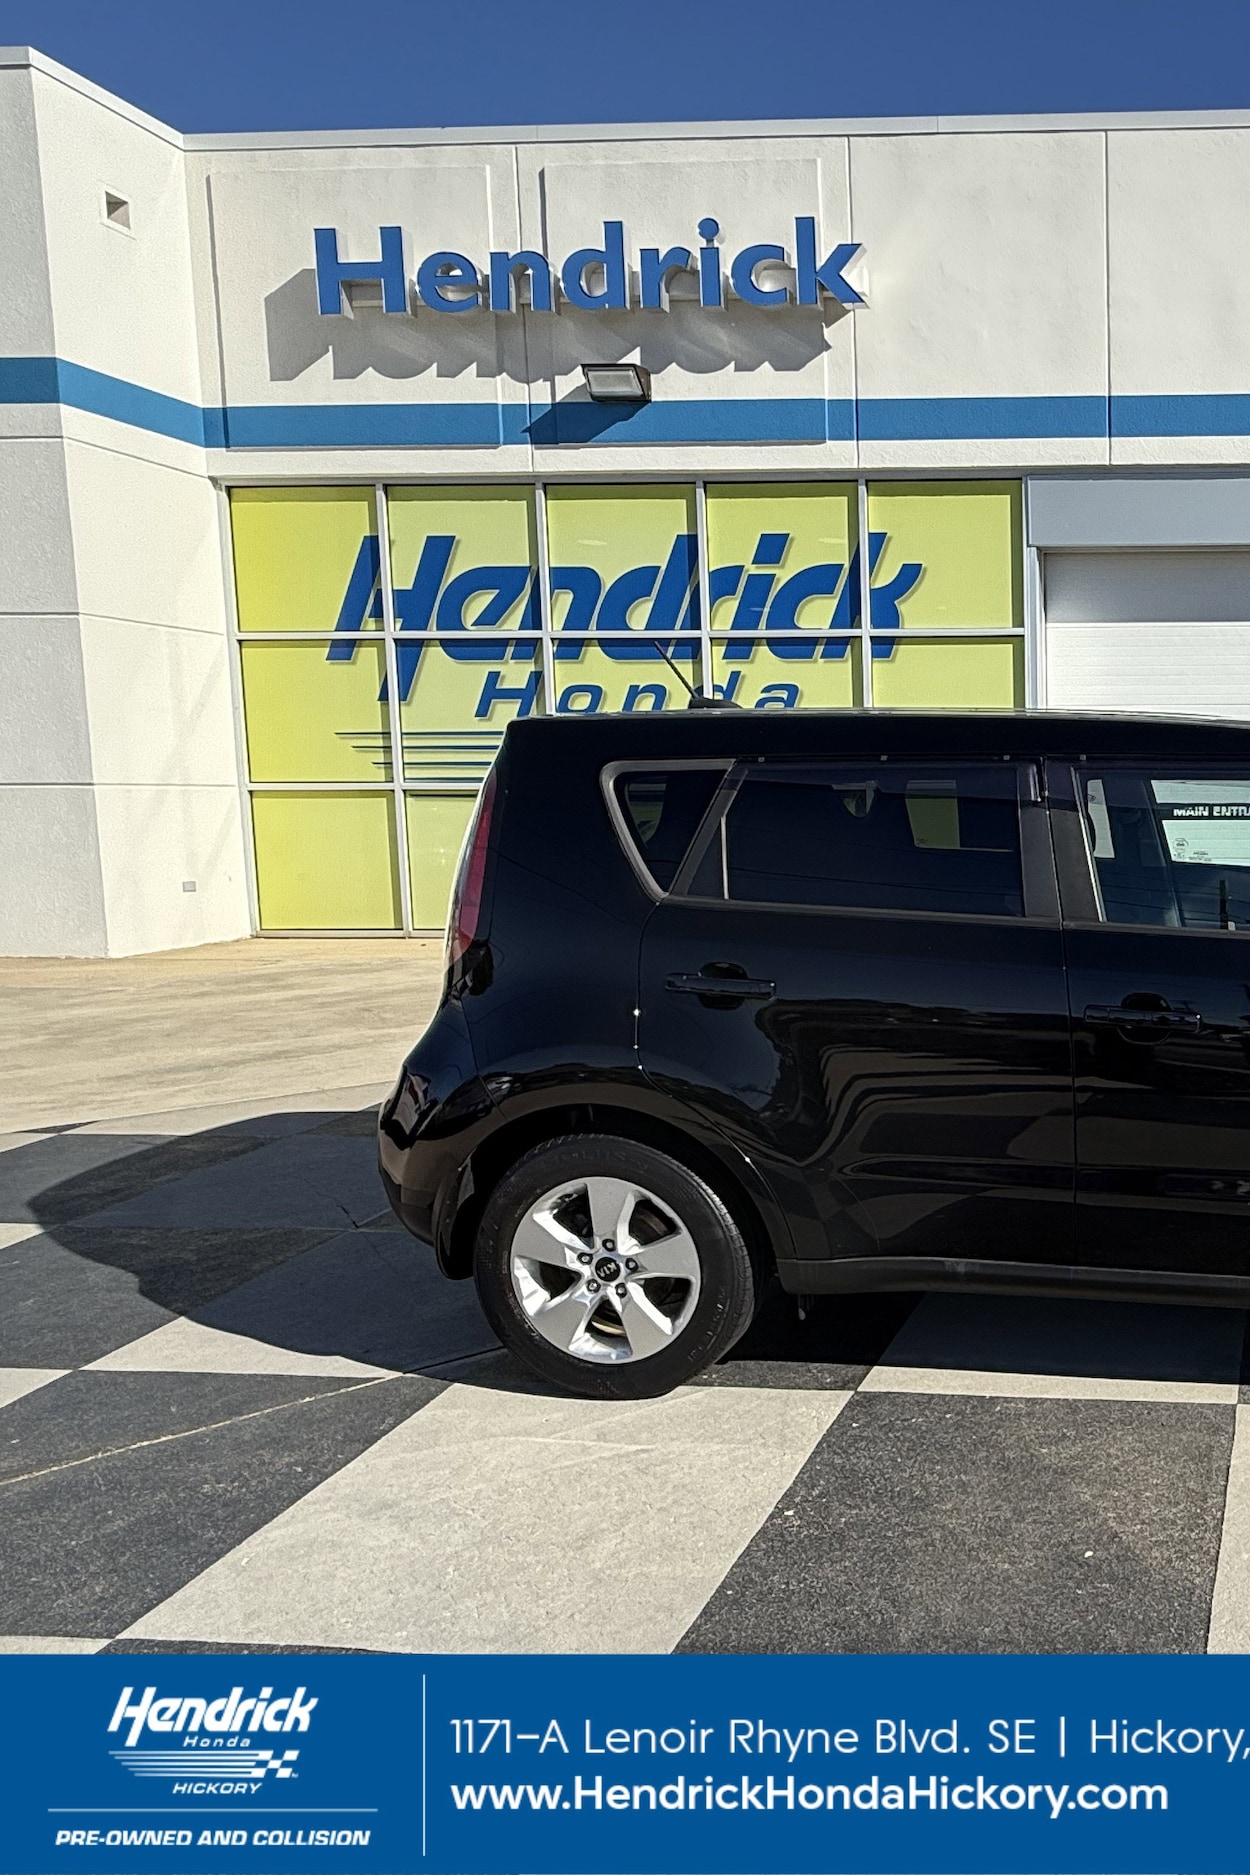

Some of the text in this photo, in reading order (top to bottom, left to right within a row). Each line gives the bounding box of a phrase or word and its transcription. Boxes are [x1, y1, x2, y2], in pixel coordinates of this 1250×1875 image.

[314, 216, 866, 314] Hendrick
[325, 532, 924, 702] Hendrick
[1173, 805, 1209, 817] MAIN
